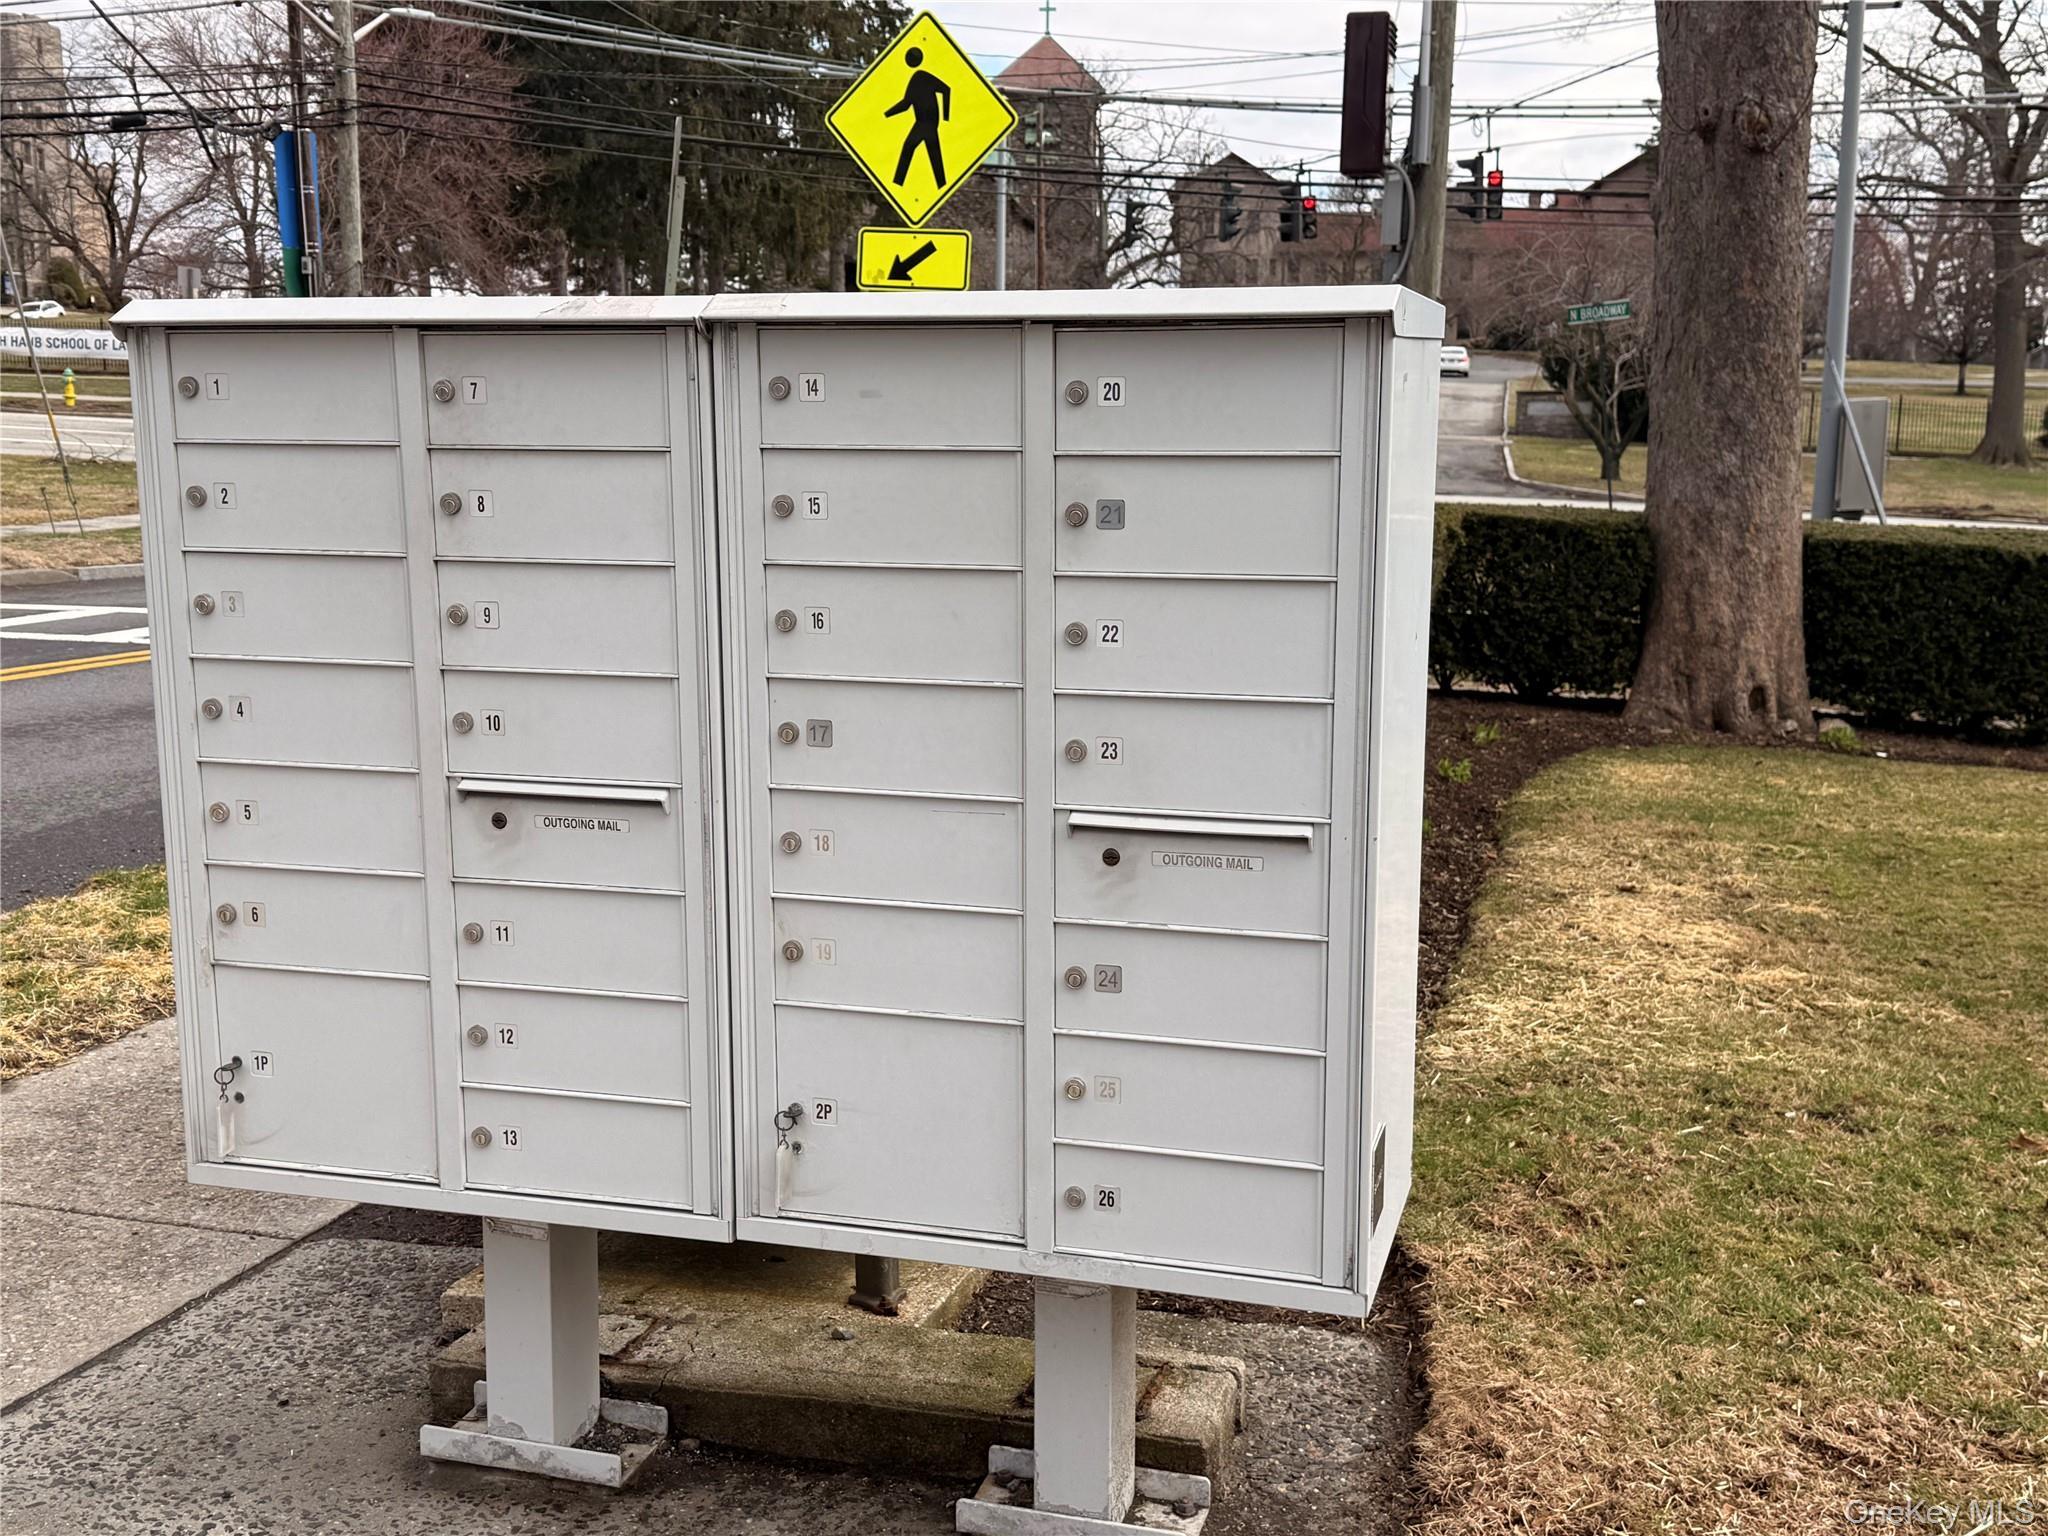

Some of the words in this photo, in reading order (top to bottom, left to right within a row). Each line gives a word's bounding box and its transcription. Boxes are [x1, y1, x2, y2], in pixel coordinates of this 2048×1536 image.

[1569, 309, 1577, 321] N
[1580, 303, 1627, 320] BROADWAY
[46, 337, 91, 350] SCHOOL
[94, 339, 109, 350] OF
[214, 379, 220, 395] 1
[470, 383, 478, 400] 7
[806, 379, 819, 397] 14
[1104, 383, 1121, 402] 20
[221, 488, 229, 505] 2
[477, 496, 485, 513] 8
[808, 497, 821, 515] 15
[1101, 506, 1121, 525] 21
[228, 597, 236, 613] 3
[483, 608, 491, 624] 9
[812, 613, 824, 630] 16
[1102, 625, 1119, 643] 22
[236, 702, 244, 718] 4
[486, 715, 501, 732] 10
[810, 726, 829, 743] 17
[1102, 742, 1118, 760] 23
[243, 804, 252, 820] 5
[543, 817, 595, 830] OUTGOING
[598, 820, 621, 832] MAIL
[815, 835, 830, 852] 18
[1162, 853, 1222, 868] OUTGOING
[1226, 857, 1253, 870] MAIL
[251, 907, 259, 923] 6
[496, 926, 509, 942] 11
[816, 944, 832, 961] 19
[1099, 970, 1118, 988] 24
[500, 1029, 514, 1045] 12
[255, 1056, 268, 1071] 1P
[1100, 1082, 1116, 1099] 25
[817, 1104, 832, 1120] 2P
[504, 1130, 518, 1146] 13
[1099, 1190, 1115, 1208] 26
